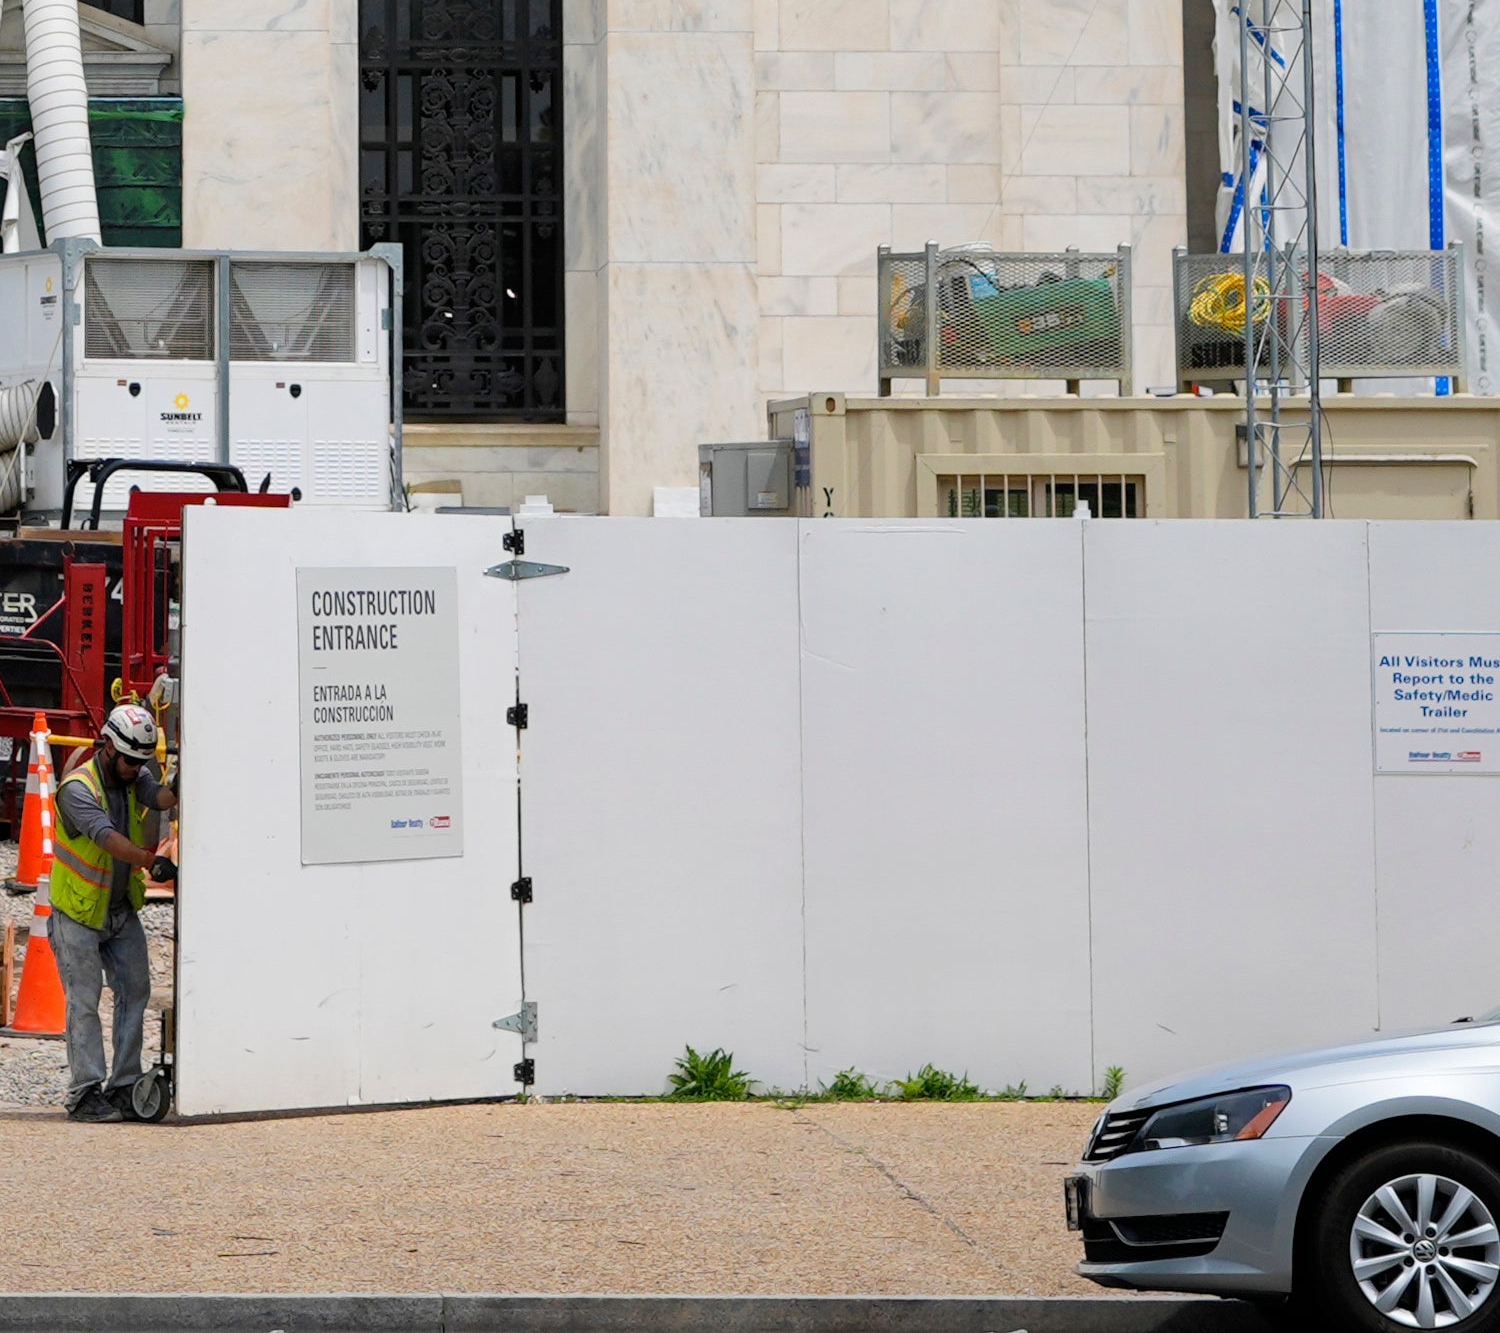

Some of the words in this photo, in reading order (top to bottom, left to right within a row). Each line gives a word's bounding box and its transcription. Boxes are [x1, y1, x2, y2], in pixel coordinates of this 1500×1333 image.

[160, 412, 202, 420] SUNBELT
[311, 589, 436, 616] CONSTRUCTION
[312, 624, 398, 650] ENTRANCE
[1378, 655, 1400, 668] All
[1404, 655, 1463, 668] Visitors
[1392, 672, 1443, 687] Report
[1449, 673, 1465, 684] to
[1469, 672, 1494, 684] the
[313, 684, 361, 702] ENTRADA
[364, 684, 372, 701] A
[373, 683, 386, 700] LA
[1393, 688, 1493, 703] Safety/Medic
[313, 700, 394, 723] CONSTRUCCIÓN
[1419, 706, 1468, 717] Trailer
